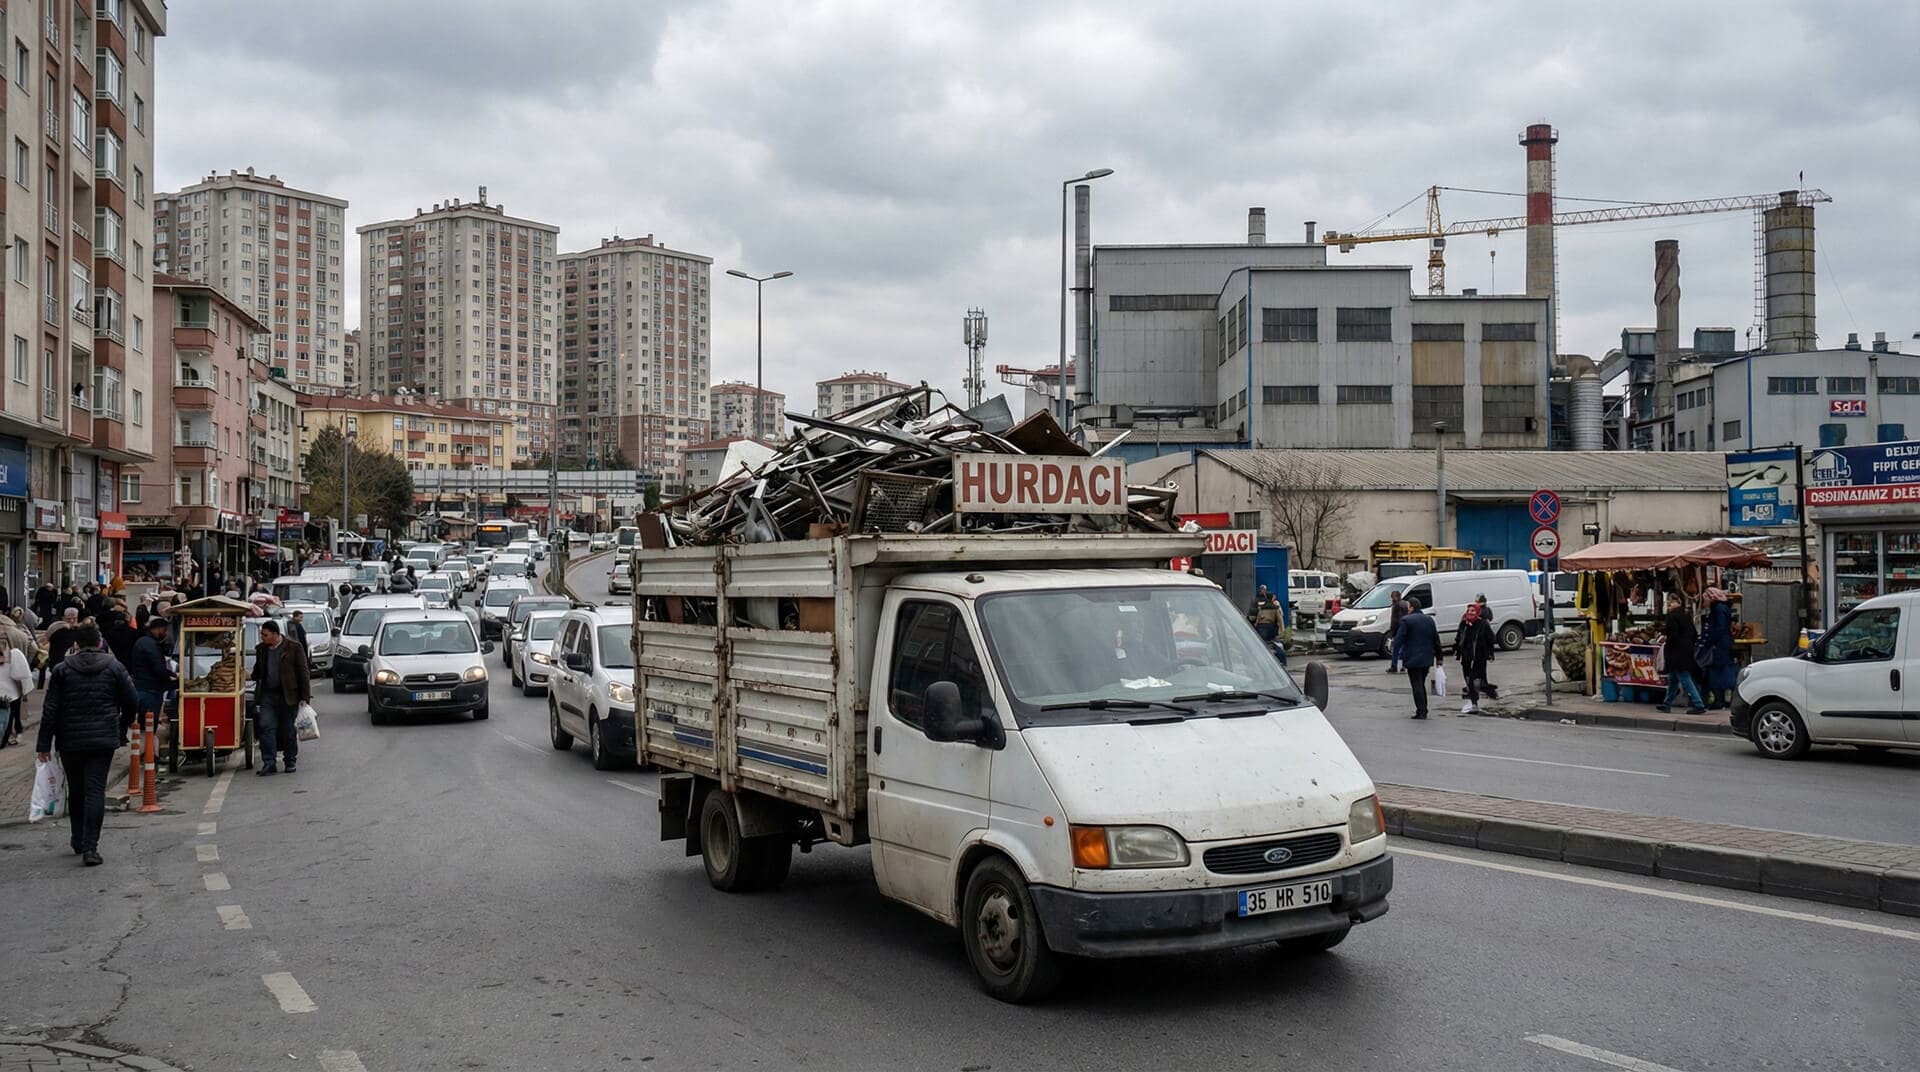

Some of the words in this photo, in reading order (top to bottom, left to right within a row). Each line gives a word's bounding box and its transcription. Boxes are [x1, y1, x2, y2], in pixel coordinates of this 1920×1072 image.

[962, 462, 1122, 506] HURDACI
[1276, 888, 1294, 908] HR
[1303, 883, 1329, 904] 510
